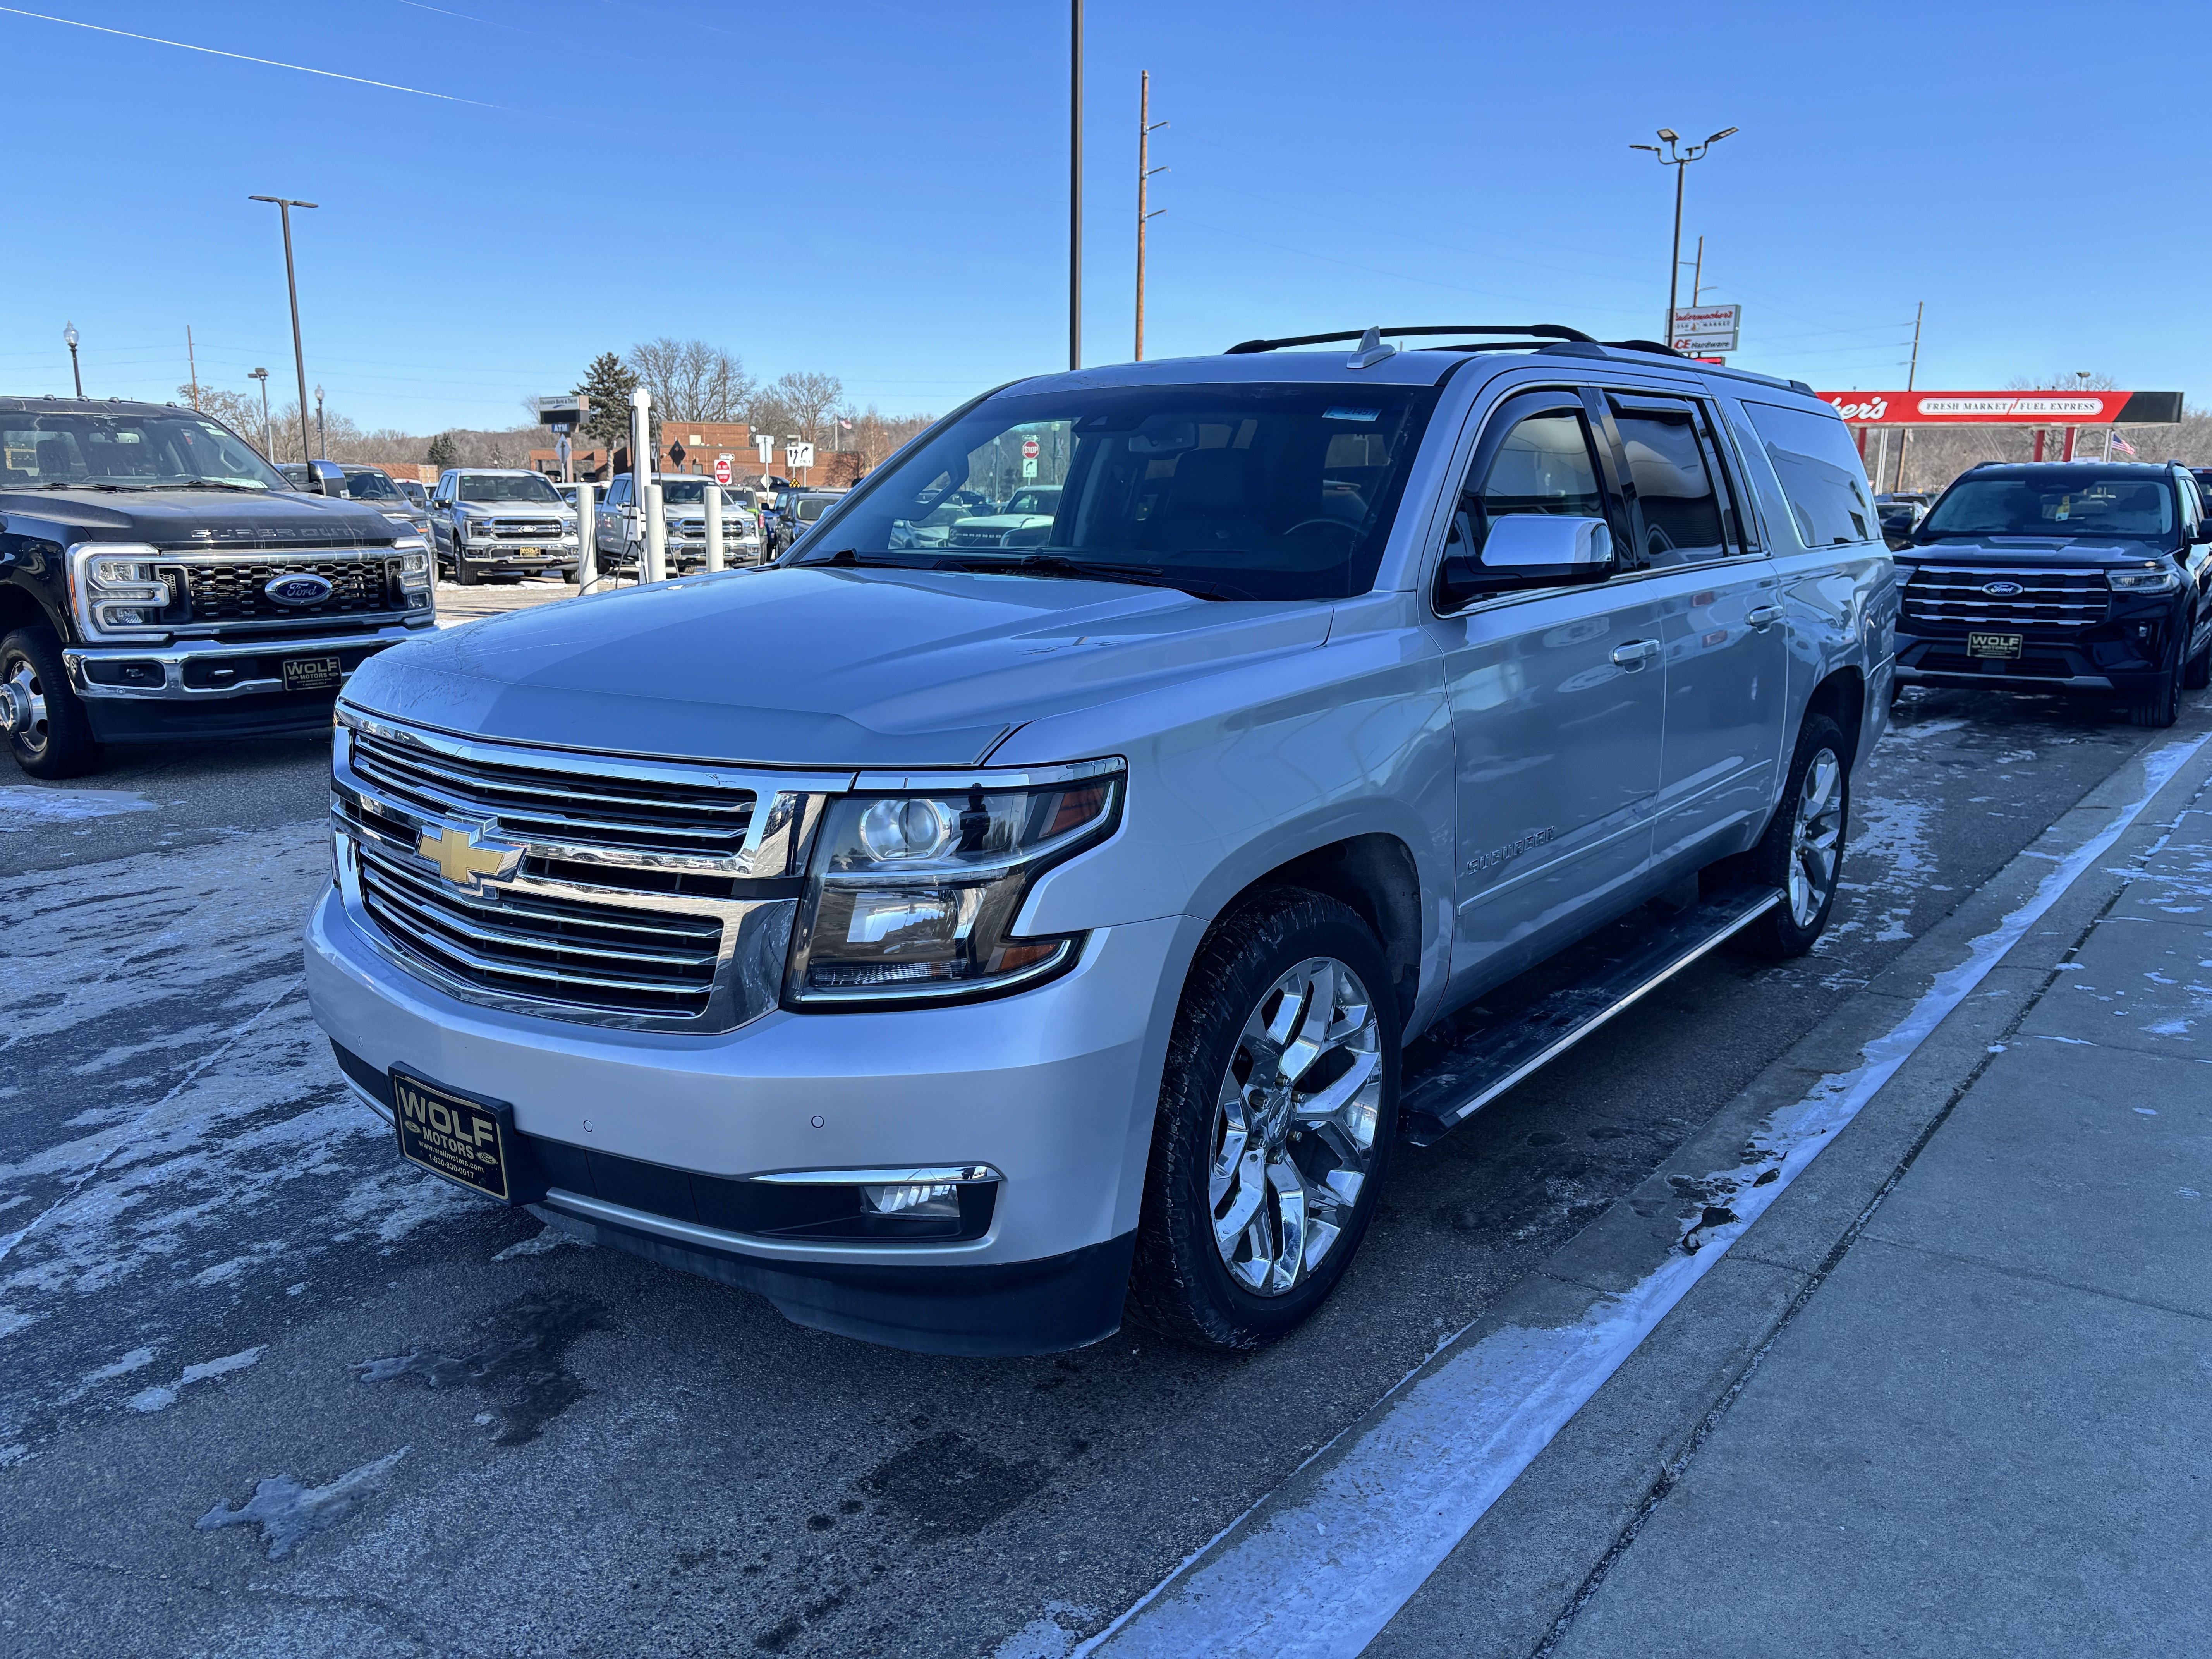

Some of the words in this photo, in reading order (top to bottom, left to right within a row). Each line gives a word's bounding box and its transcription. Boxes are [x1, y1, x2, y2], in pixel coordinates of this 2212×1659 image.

[2050, 402, 2095, 410] EXPRESS
[191, 529, 295, 538] SUPER
[300, 527, 367, 537] DUTY
[287, 583, 317, 596] Ford
[1990, 584, 2014, 592] Ford
[1972, 636, 2019, 646] WOLF
[287, 661, 337, 675] WOLF
[399, 1087, 493, 1147] WOLF
[407, 1122, 418, 1132] Ford
[422, 1126, 474, 1159] MOTORS
[418, 1140, 484, 1173] www.wolfmotors.com
[480, 1152, 493, 1163] Ford
